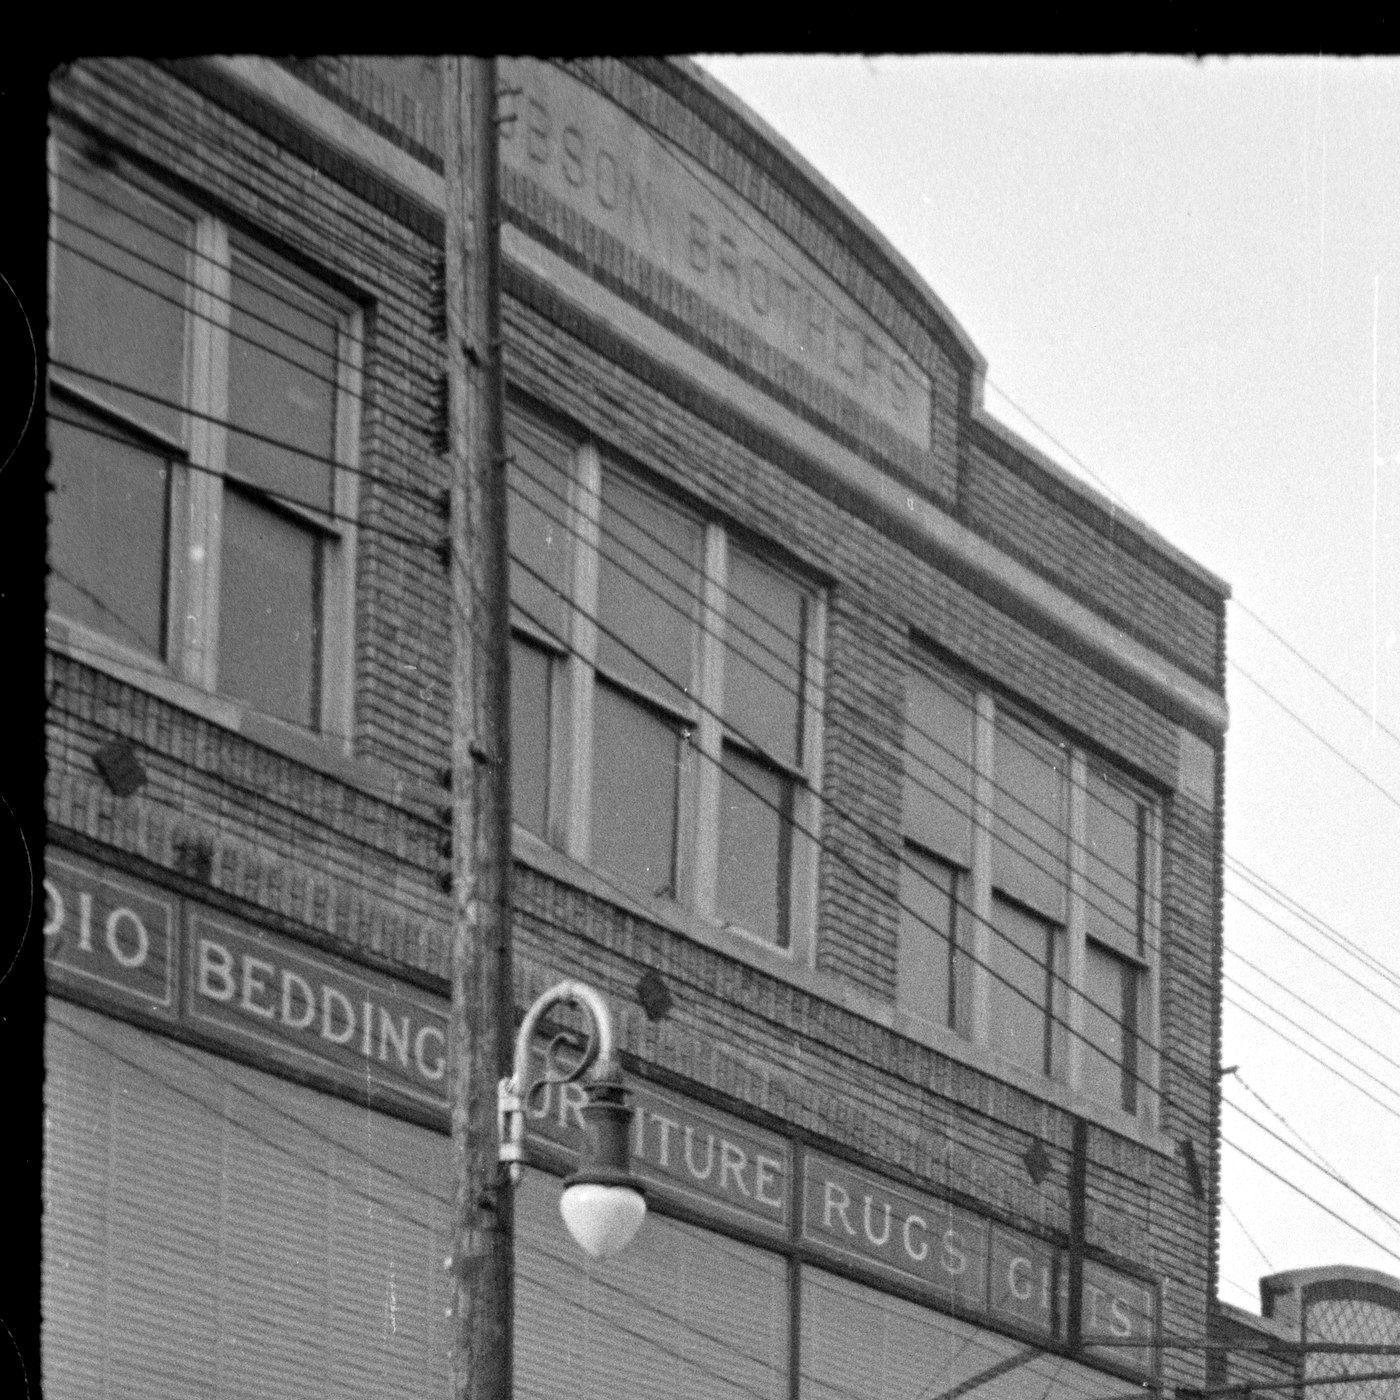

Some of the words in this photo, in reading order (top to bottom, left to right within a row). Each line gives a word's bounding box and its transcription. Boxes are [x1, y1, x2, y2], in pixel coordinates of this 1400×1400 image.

[503, 84, 657, 237] BSON
[196, 940, 449, 1081] BEDDING
[526, 1078, 783, 1209] URITURE
[822, 1181, 967, 1276] RUGS
[1008, 1256, 1133, 1338] GITS
